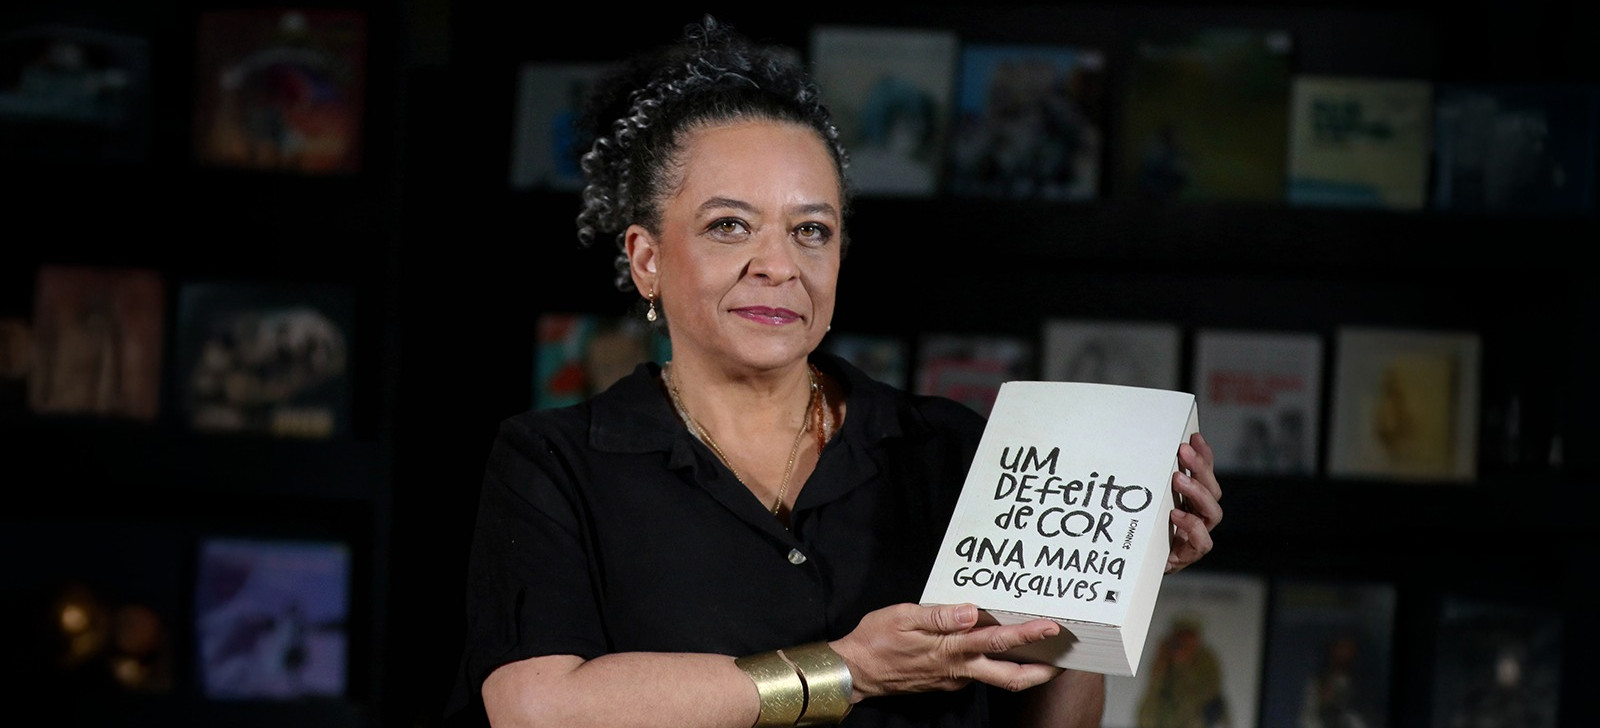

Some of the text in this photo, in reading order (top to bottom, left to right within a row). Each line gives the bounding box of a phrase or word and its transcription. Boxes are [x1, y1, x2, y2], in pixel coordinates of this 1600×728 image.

[1000, 446, 1060, 475] UM
[995, 505, 1113, 543] de COR
